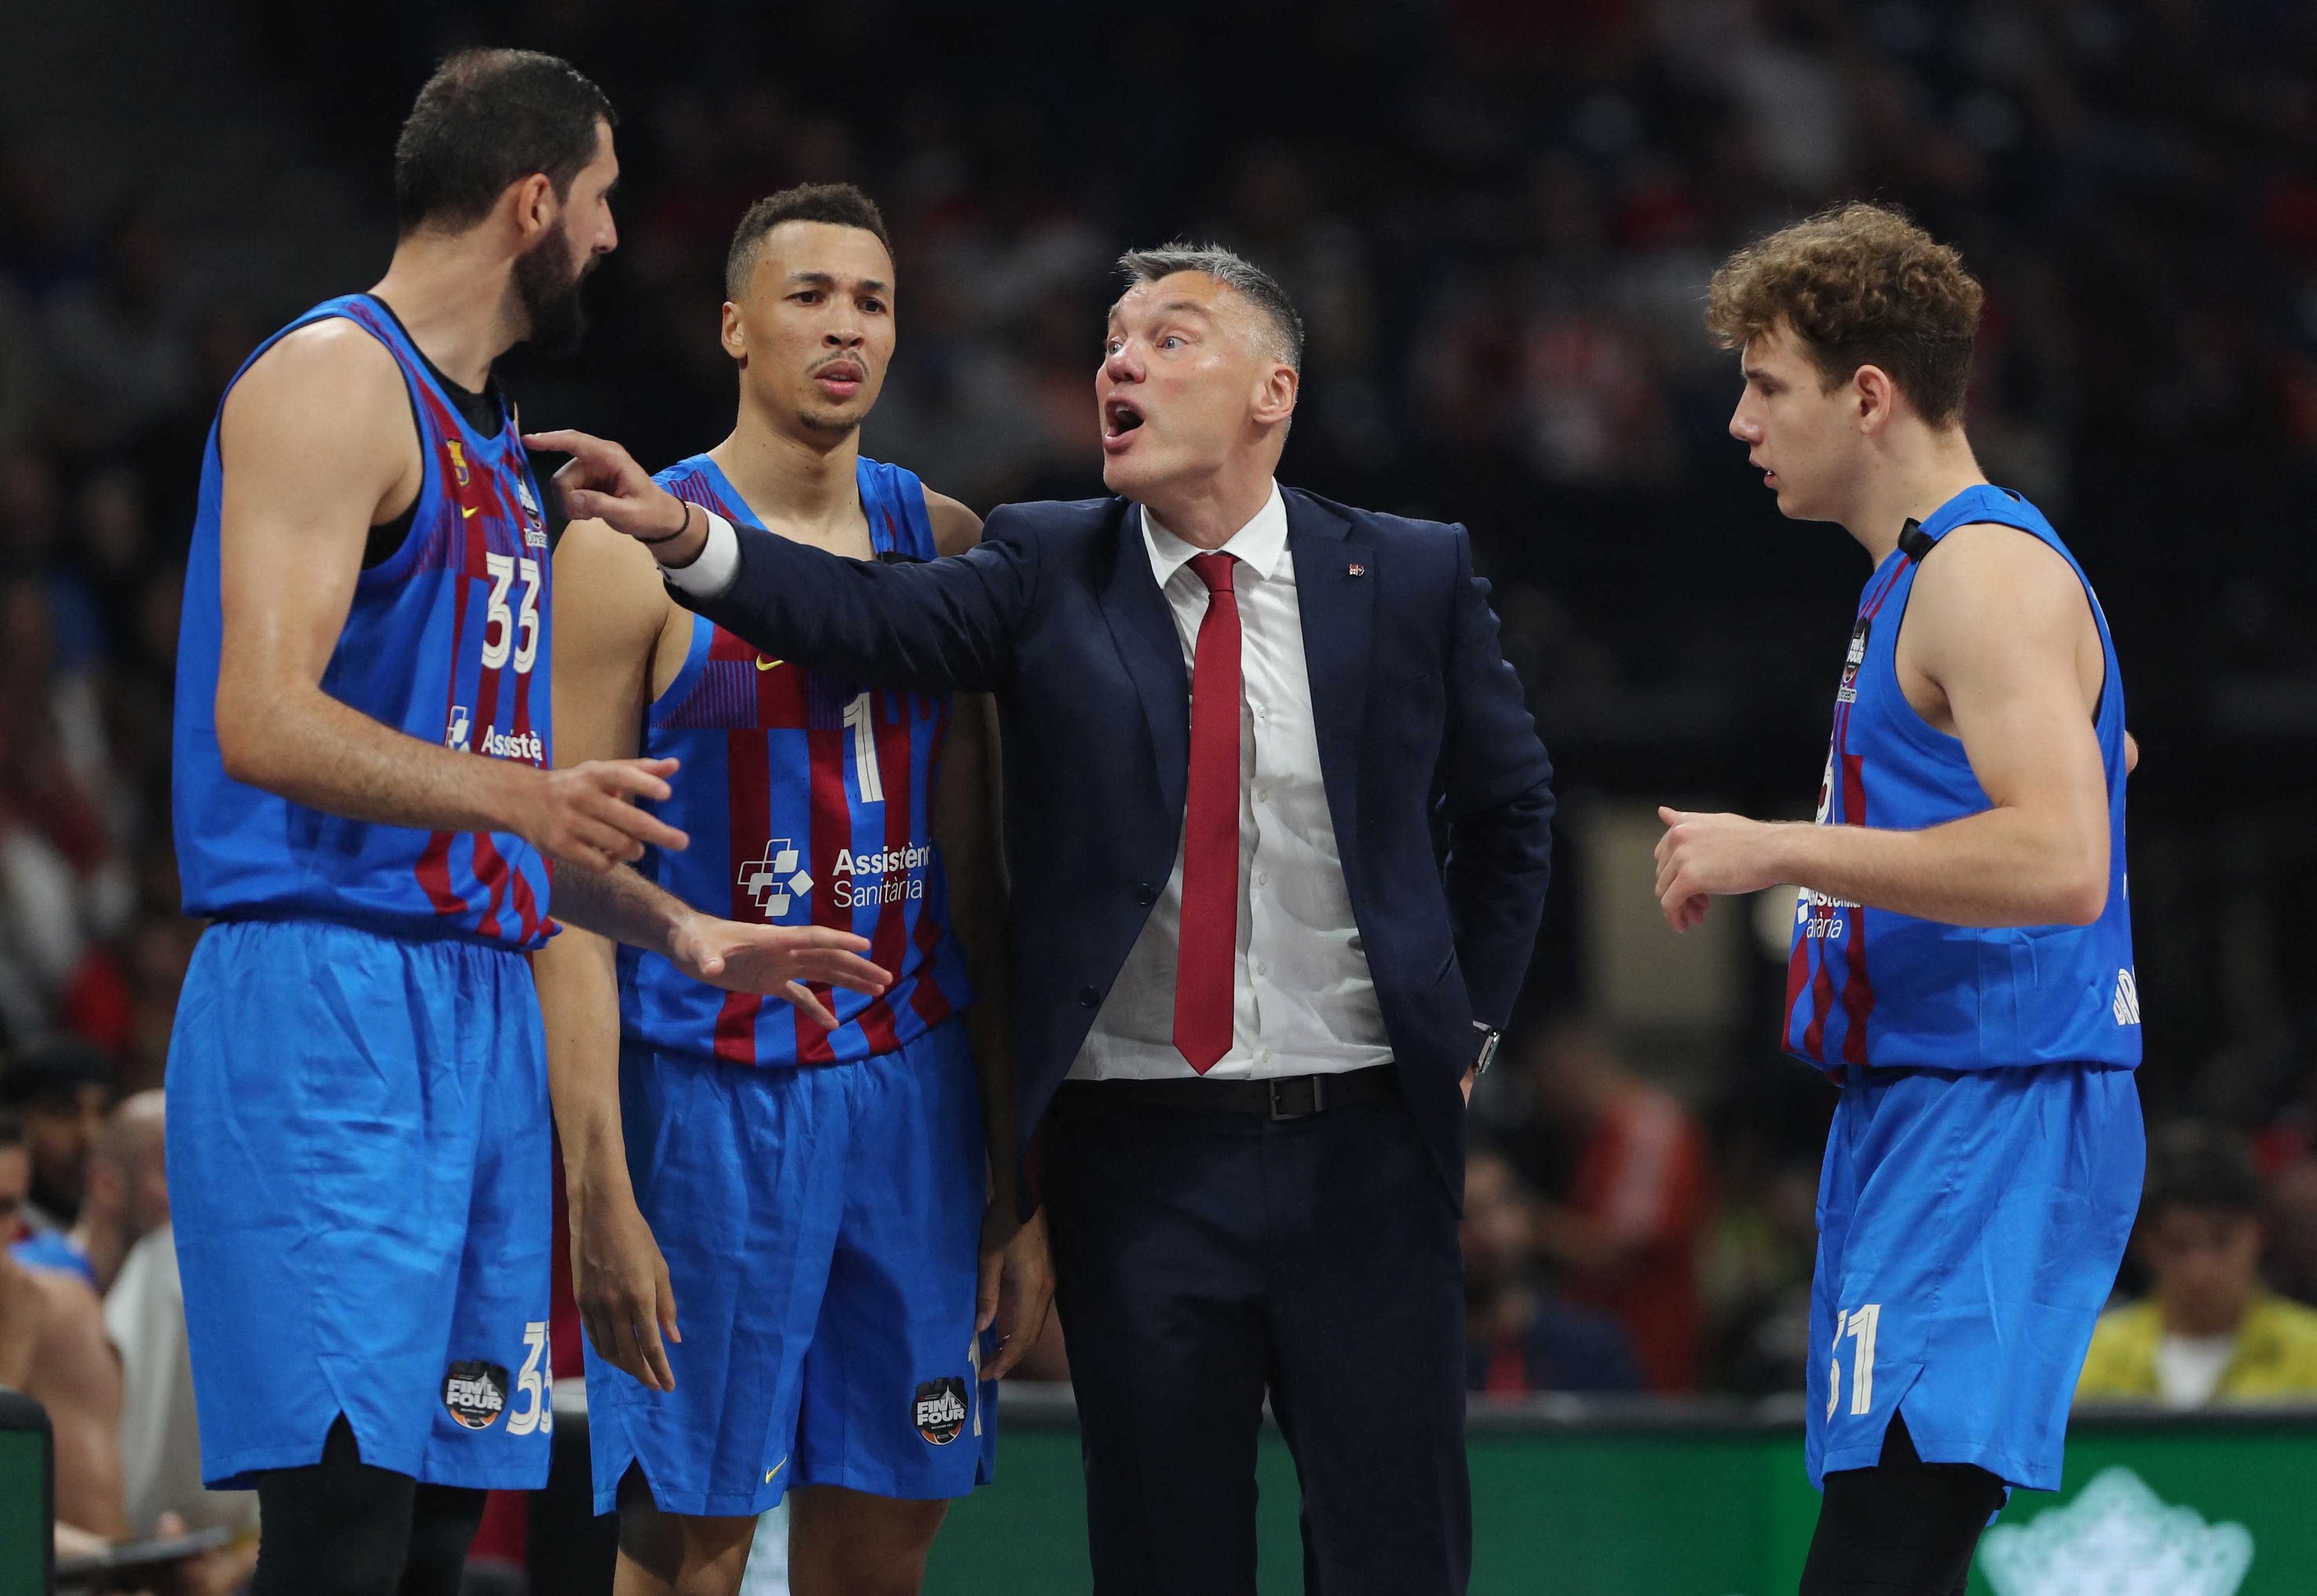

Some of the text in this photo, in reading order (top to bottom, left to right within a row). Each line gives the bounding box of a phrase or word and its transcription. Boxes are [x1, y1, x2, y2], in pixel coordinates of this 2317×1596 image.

[481, 551, 540, 674] 33
[843, 692, 885, 804] 1
[833, 873, 923, 908] Sanitària
[446, 1392, 503, 1411] FOUR
[917, 1408, 964, 1426] FOUR
